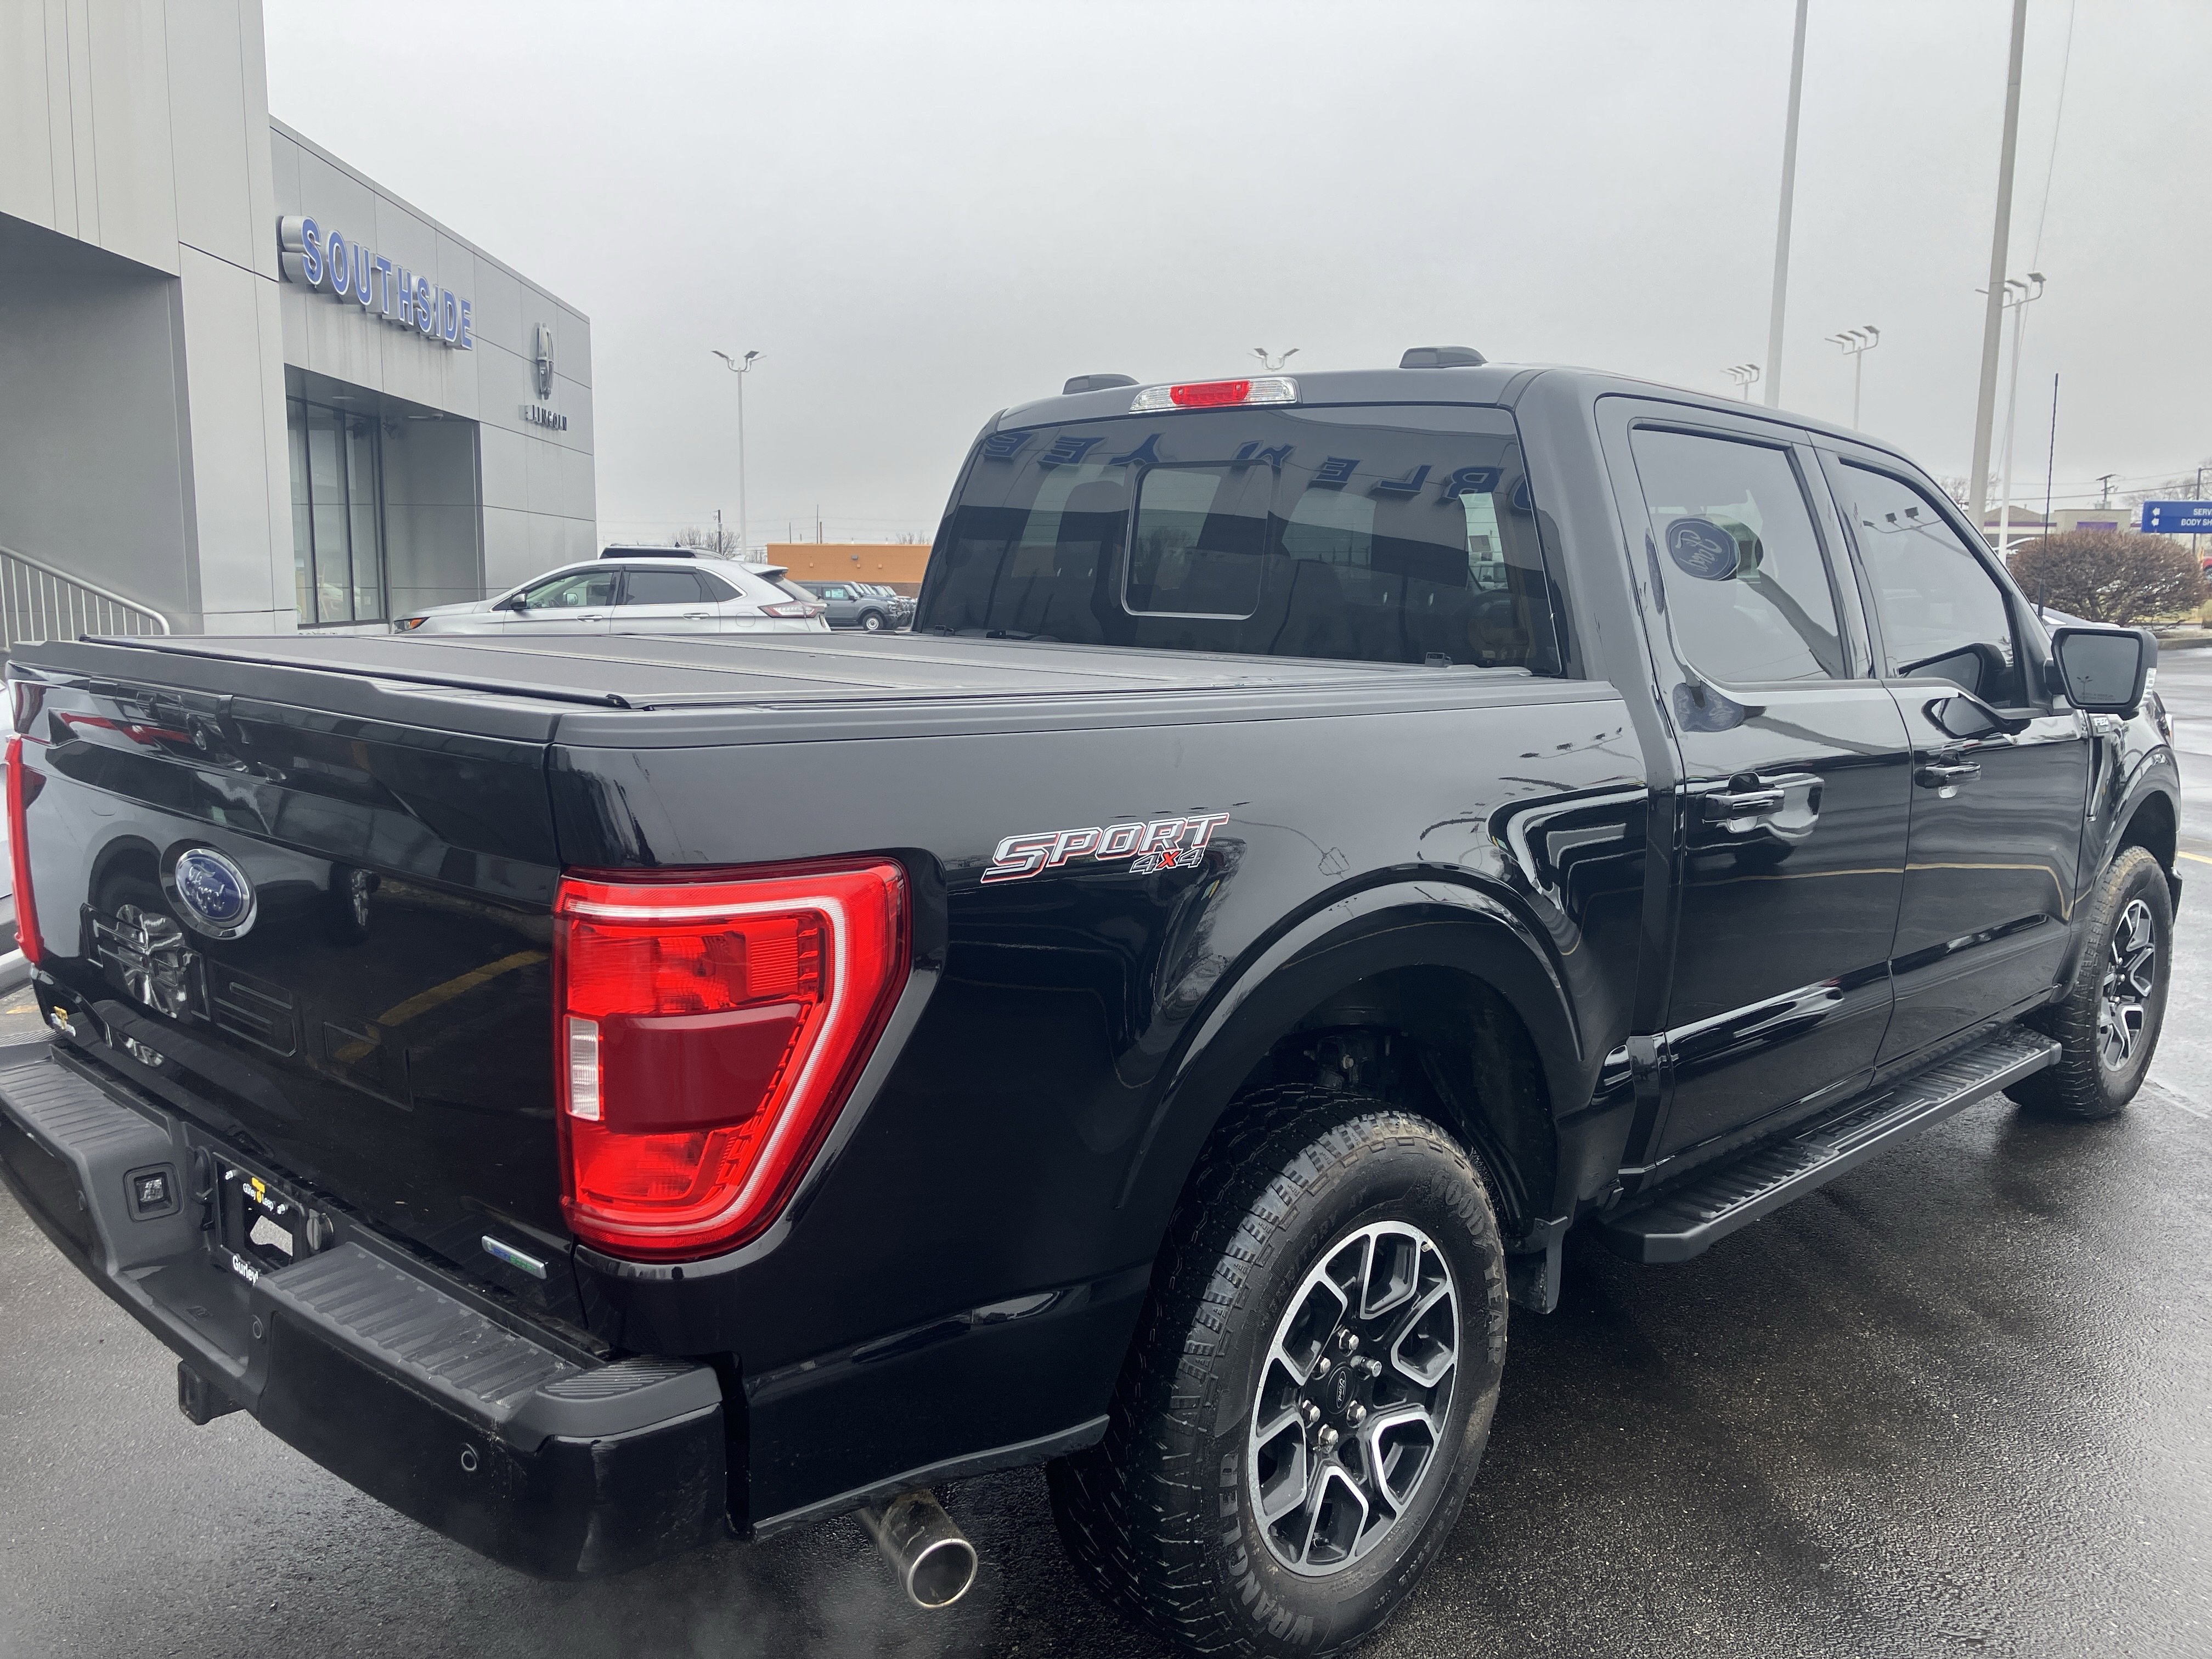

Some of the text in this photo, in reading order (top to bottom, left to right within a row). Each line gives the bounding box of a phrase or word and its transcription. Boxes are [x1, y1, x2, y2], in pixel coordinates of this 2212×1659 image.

[291, 216, 473, 351] SOUTHSIDE
[527, 404, 567, 431] LINCOLN
[981, 812, 1230, 884] SPORT
[185, 864, 226, 914] Ford
[232, 1255, 257, 1286] Gurley
[1430, 1169, 1506, 1365] GOODYEAR
[1338, 1378, 1346, 1403] Ford
